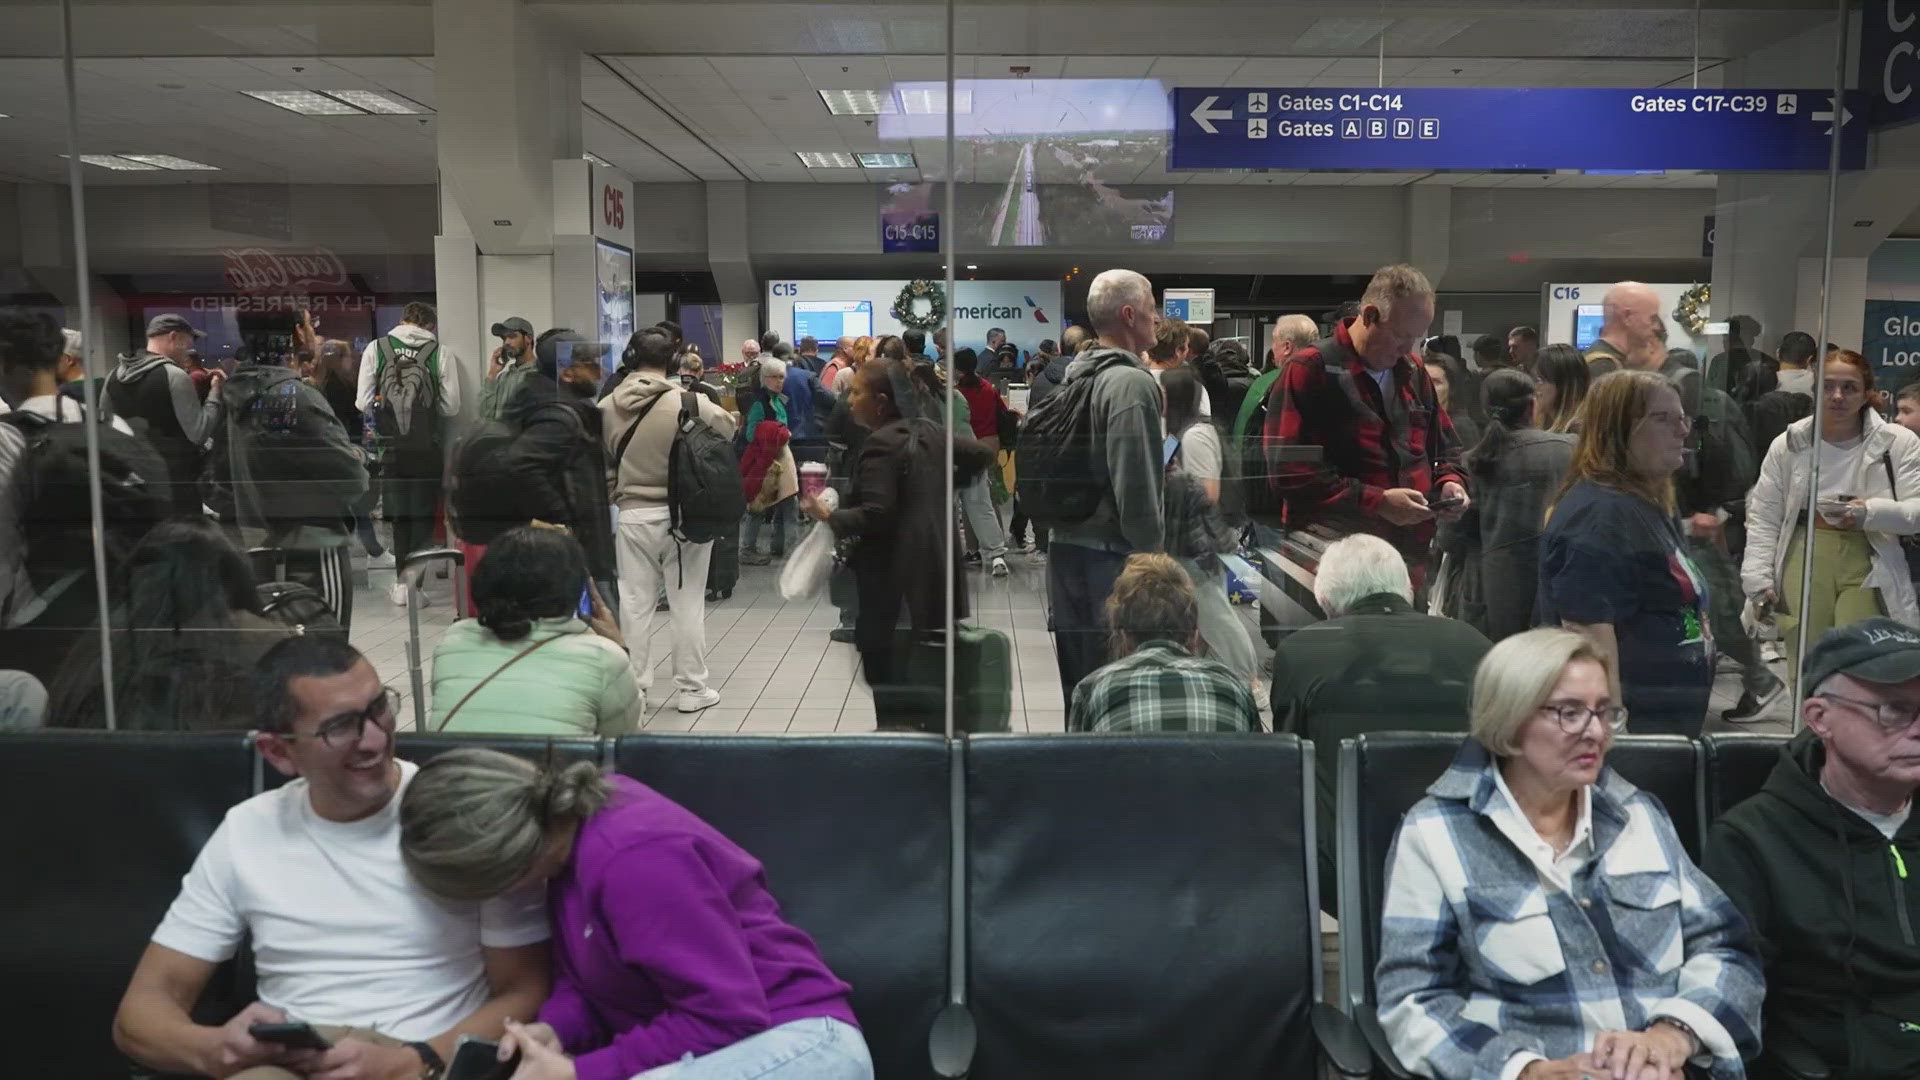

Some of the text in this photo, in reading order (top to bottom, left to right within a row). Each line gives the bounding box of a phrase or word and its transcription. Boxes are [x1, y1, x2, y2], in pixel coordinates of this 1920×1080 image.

[1278, 94, 1403, 111] Gates C1-C14
[1631, 95, 1767, 112] Gates C17-C39
[1278, 120, 1435, 137] Gates A B D E
[604, 184, 624, 230] C15
[772, 283, 798, 296] C15
[1553, 287, 1580, 300] C16
[953, 303, 1022, 319] merican
[1884, 315, 1920, 336] Glo
[1882, 347, 1920, 367] Loc
